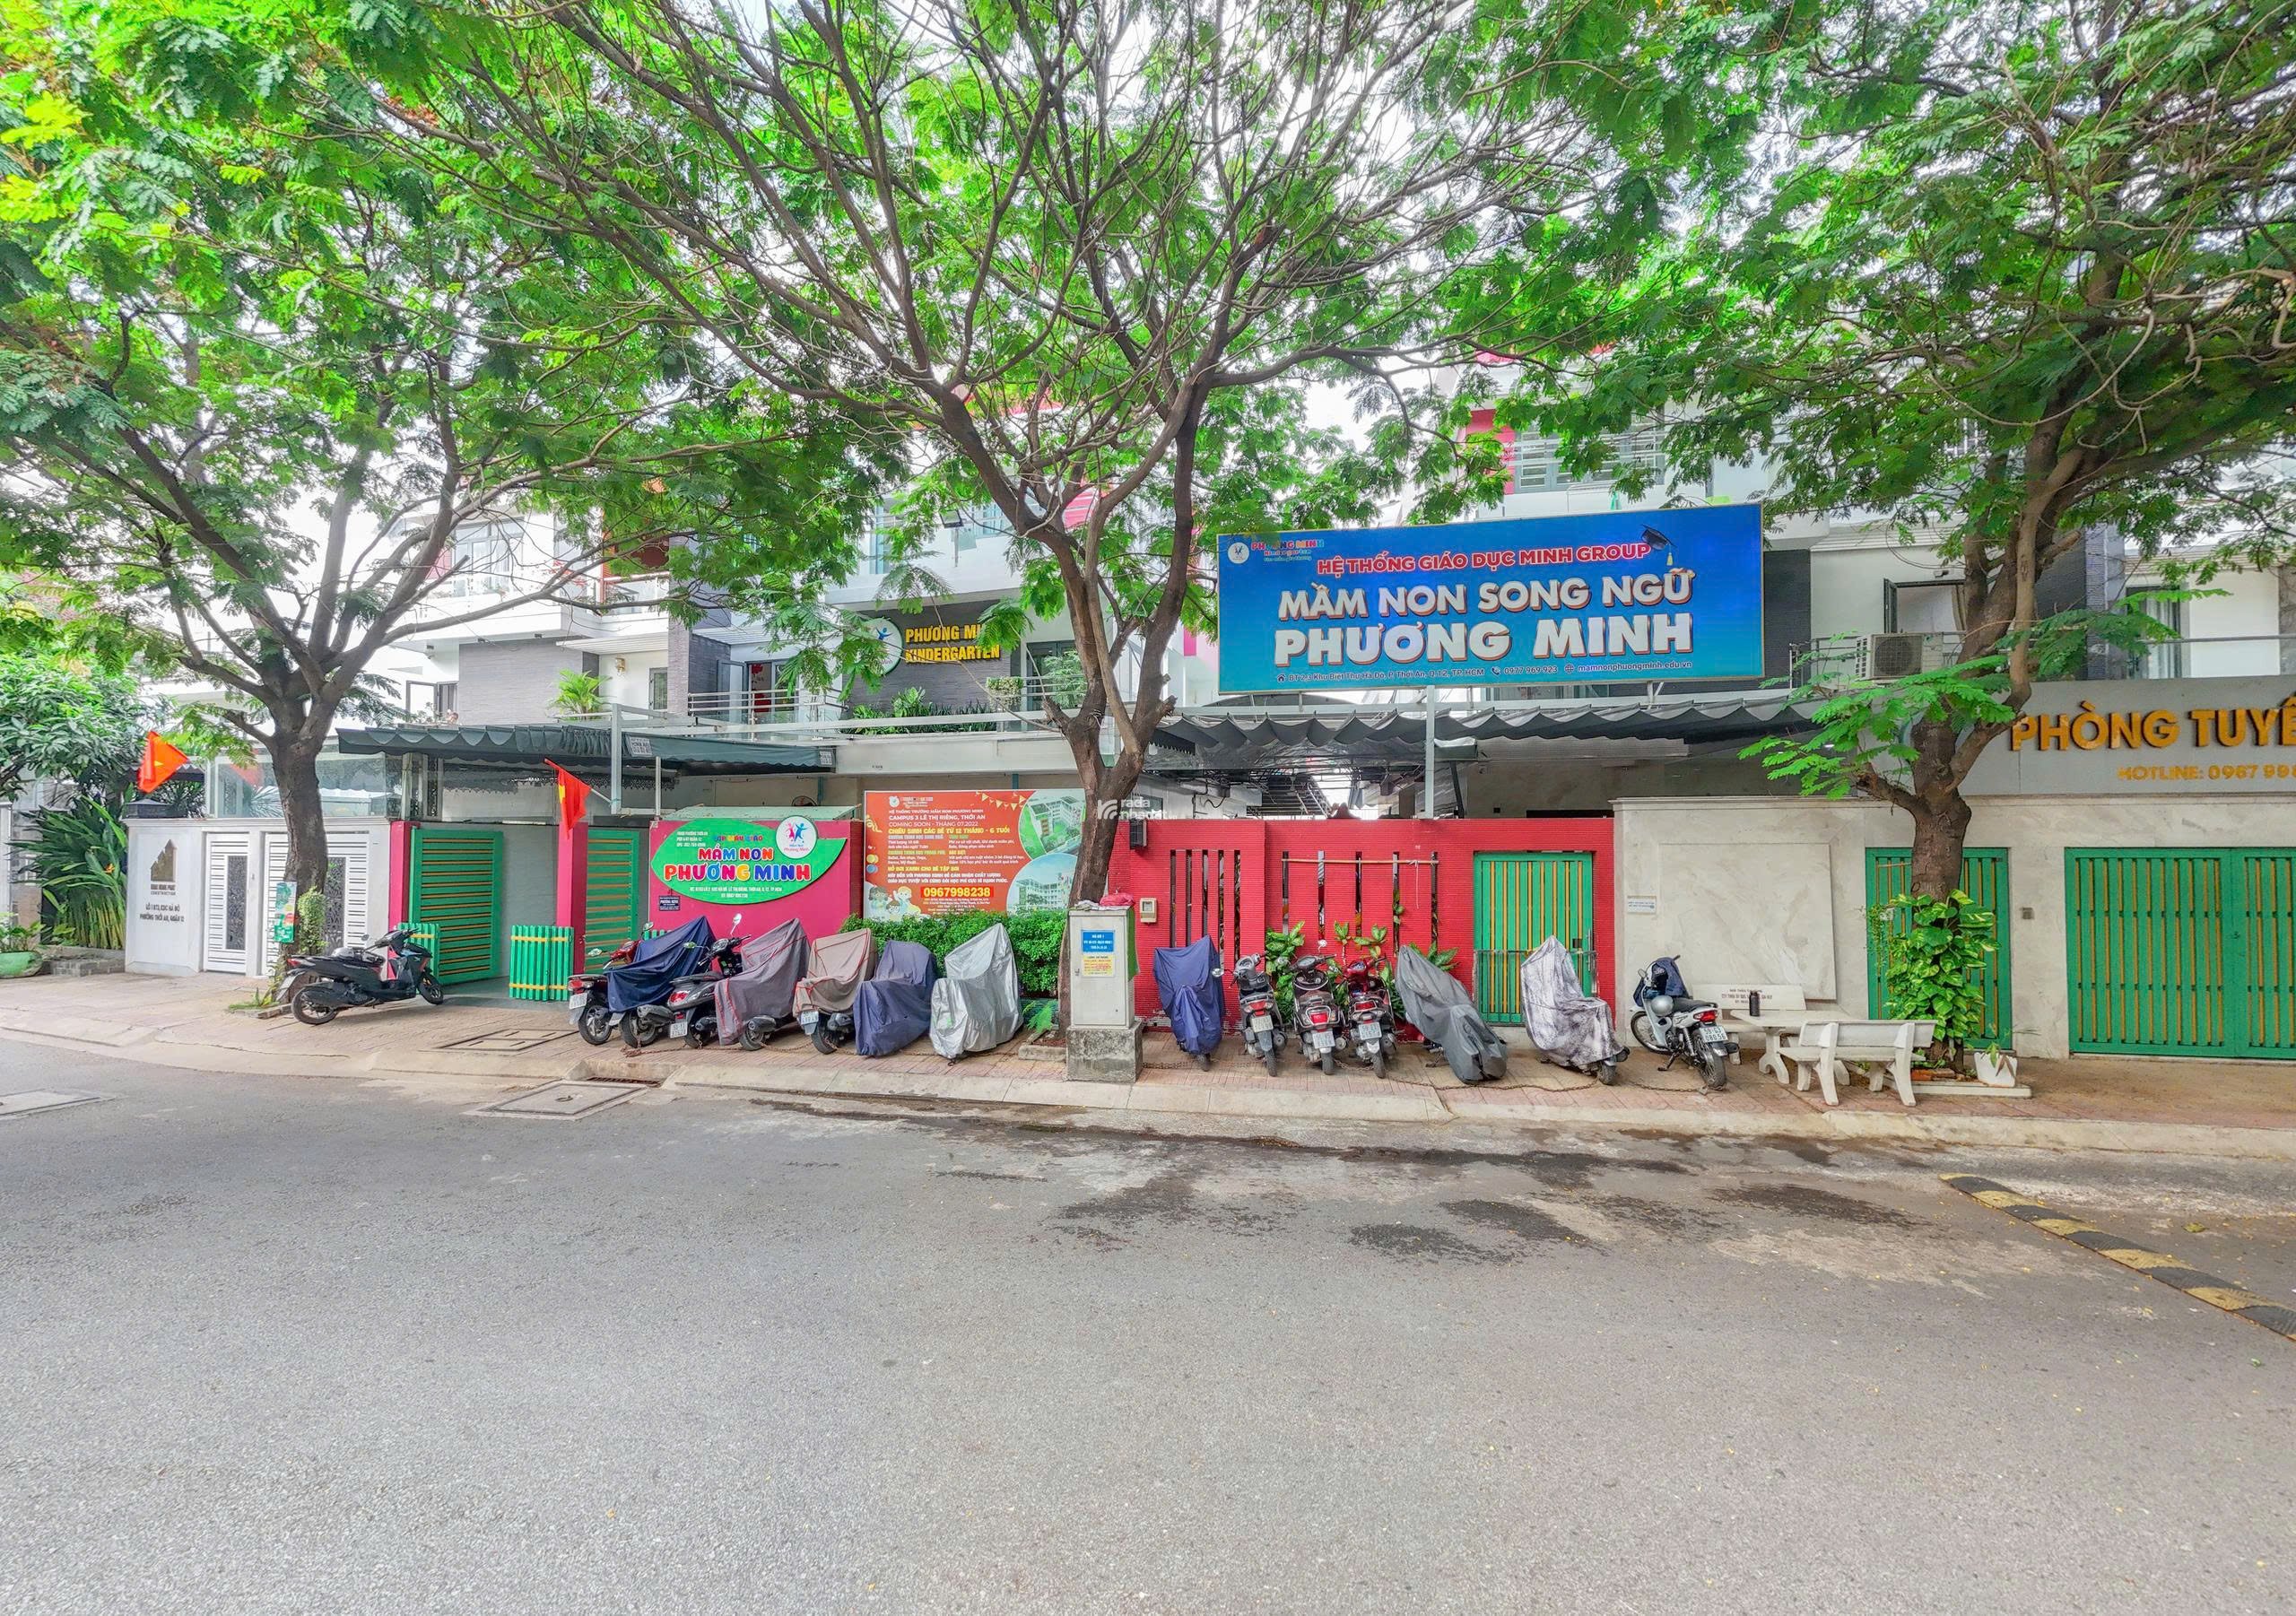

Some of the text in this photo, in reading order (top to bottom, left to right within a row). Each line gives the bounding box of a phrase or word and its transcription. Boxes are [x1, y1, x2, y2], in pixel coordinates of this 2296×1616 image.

[1318, 543, 1651, 578] HỆ THỐNG GIÁO DỤC MINH GROUP
[1278, 567, 1696, 621] MẦM NON SONG NGỮ
[905, 623, 960, 643] PHƯƠNG
[1274, 613, 1693, 667] PHƯƠNG MINH
[2010, 699, 2180, 752] PHÒNG
[2117, 765, 2204, 780] HOTLINE:
[698, 843, 774, 861] MẦM NON
[664, 862, 812, 882] PHƯƠNG MINH
[924, 887, 991, 897] 0967998238
